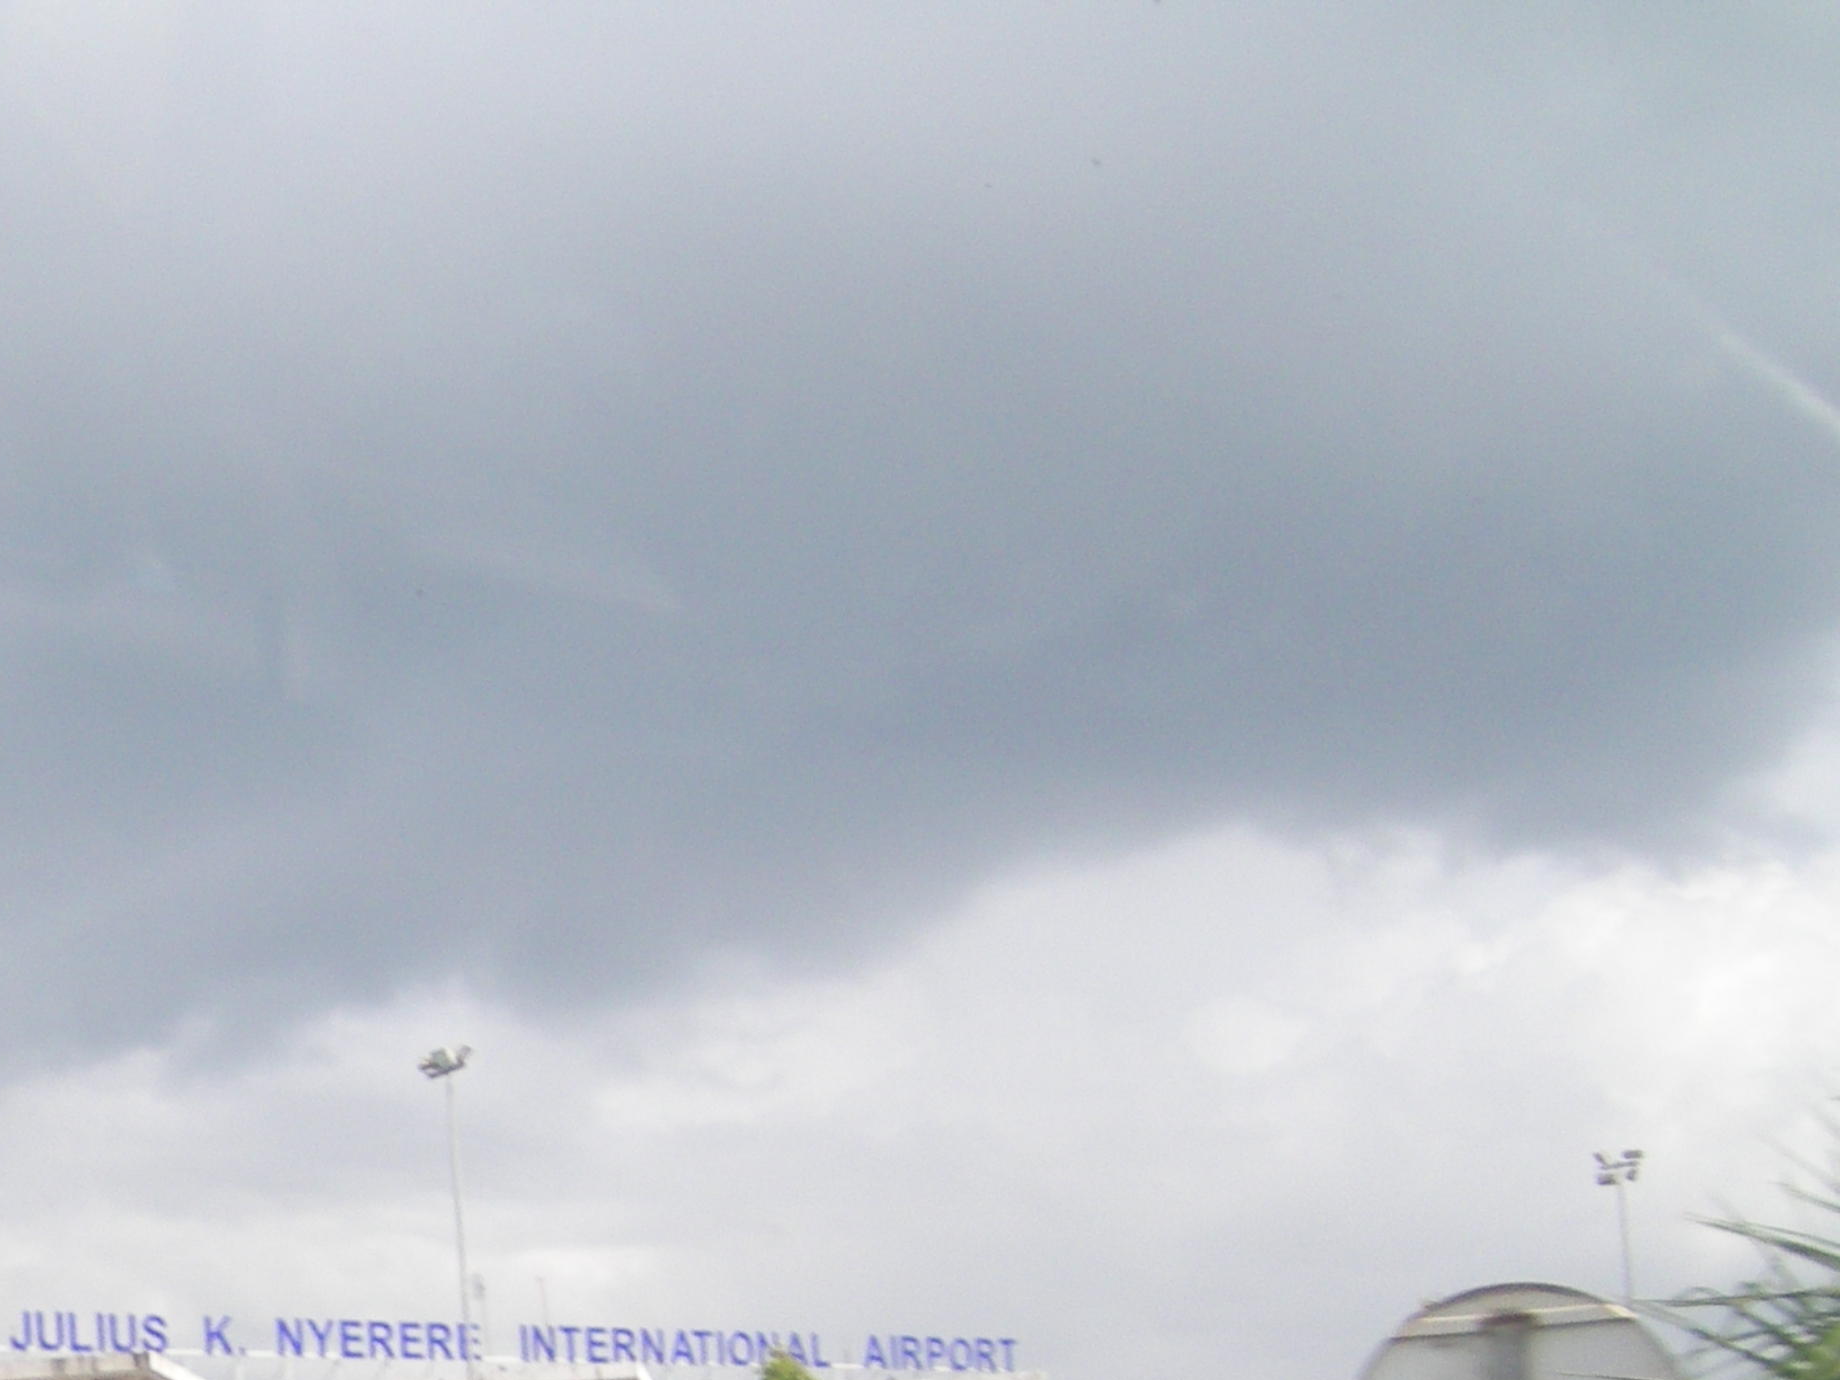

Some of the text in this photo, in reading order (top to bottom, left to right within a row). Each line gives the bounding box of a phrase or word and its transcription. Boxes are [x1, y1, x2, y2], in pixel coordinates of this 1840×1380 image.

[10, 1310, 168, 1354] JULIUS
[276, 1318, 481, 1361] NYERERE
[519, 1324, 831, 1368] INTERNATIONAL
[863, 1333, 1017, 1373] AIRPORT
